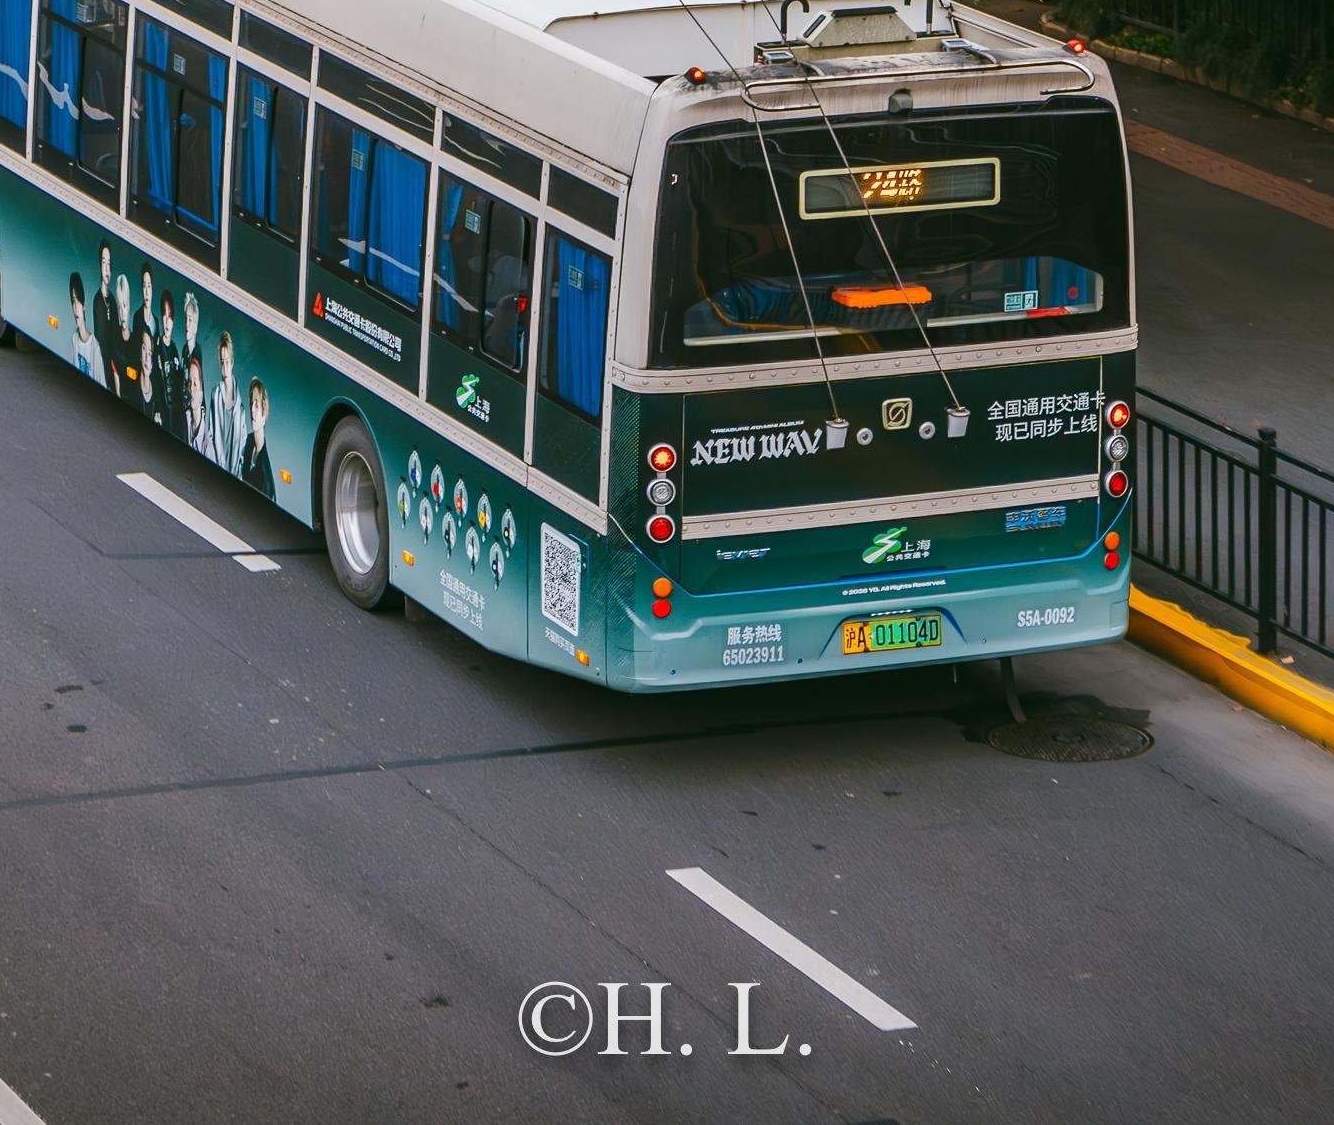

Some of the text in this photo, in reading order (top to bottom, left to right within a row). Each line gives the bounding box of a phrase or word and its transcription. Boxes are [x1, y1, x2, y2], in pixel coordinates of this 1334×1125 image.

[987, 390, 1106, 421] 全国通用交通卡
[995, 414, 1097, 442] 现已同步上线
[690, 435, 756, 467] NEW
[900, 539, 931, 553] 上海
[1017, 606, 1075, 628] S5A-0092
[727, 624, 782, 645] 服务热线
[722, 646, 785, 666] 65023911
